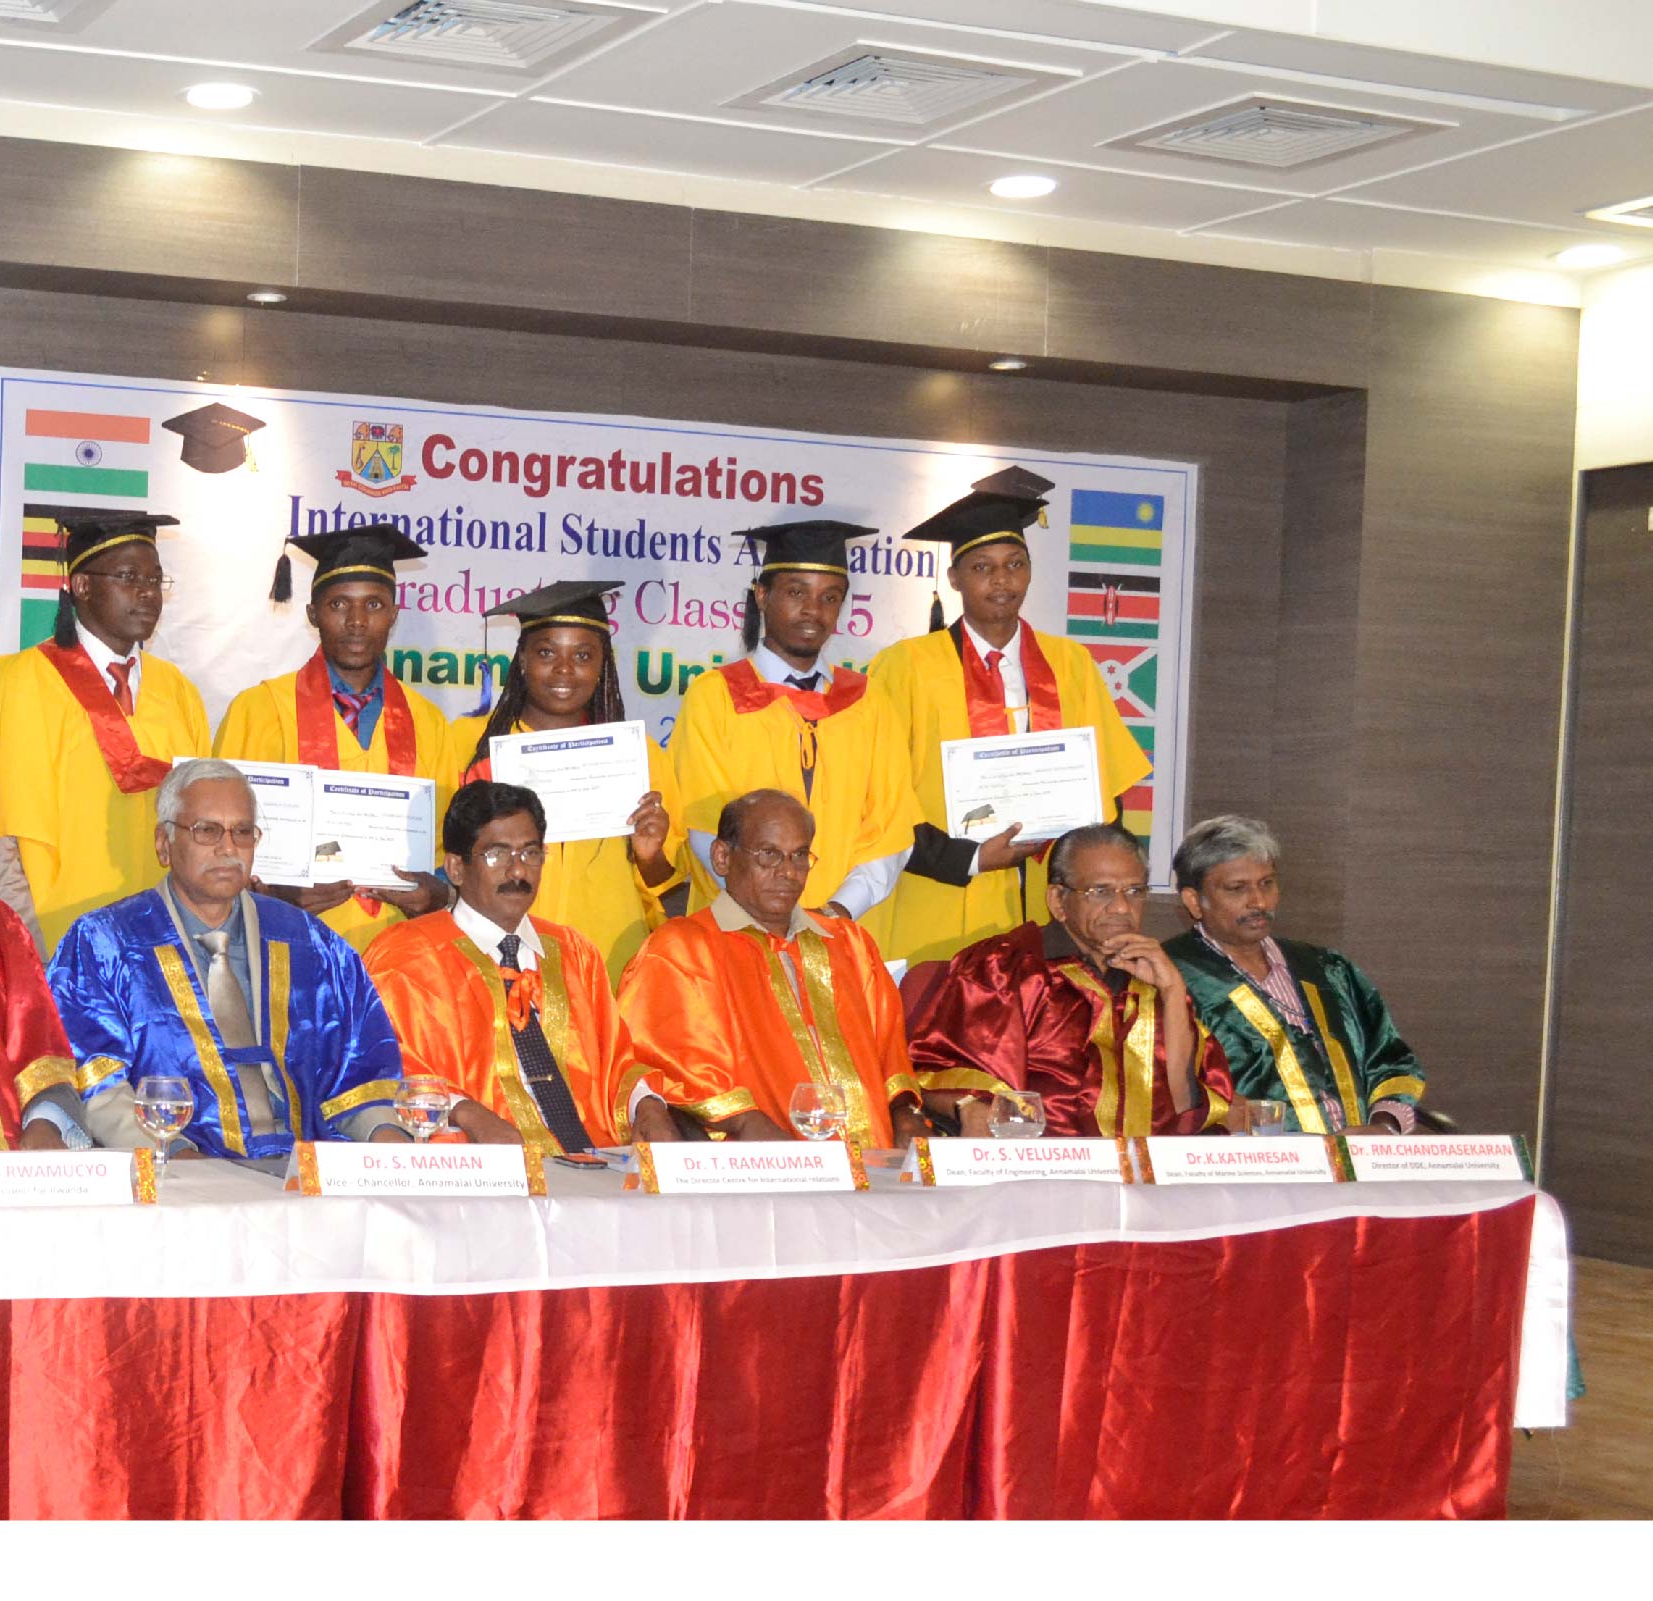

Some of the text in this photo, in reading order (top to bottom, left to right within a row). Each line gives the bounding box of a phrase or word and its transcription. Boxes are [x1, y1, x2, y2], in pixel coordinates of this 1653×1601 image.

[421, 433, 824, 506] Congratulations
[561, 513, 721, 565] Students
[635, 579, 747, 635] Class
[973, 1148, 1091, 1161] Dr. S. VELUSAMI
[1350, 1144, 1513, 1156] Dr. RM.CHANDRASEKARAN
[363, 1155, 483, 1170] Dr. S. MANIAN
[683, 1156, 824, 1170] Dr. T. RAMKUMAR
[1186, 1152, 1300, 1165] Dr.K.KATHIRESAN
[6, 1163, 107, 1178] RWAMUCYO
[1049, 1168, 1087, 1176] Annamalai
[326, 1178, 347, 1187] Vice
[418, 1178, 472, 1187] Annamalai
[474, 1178, 525, 1189] University
